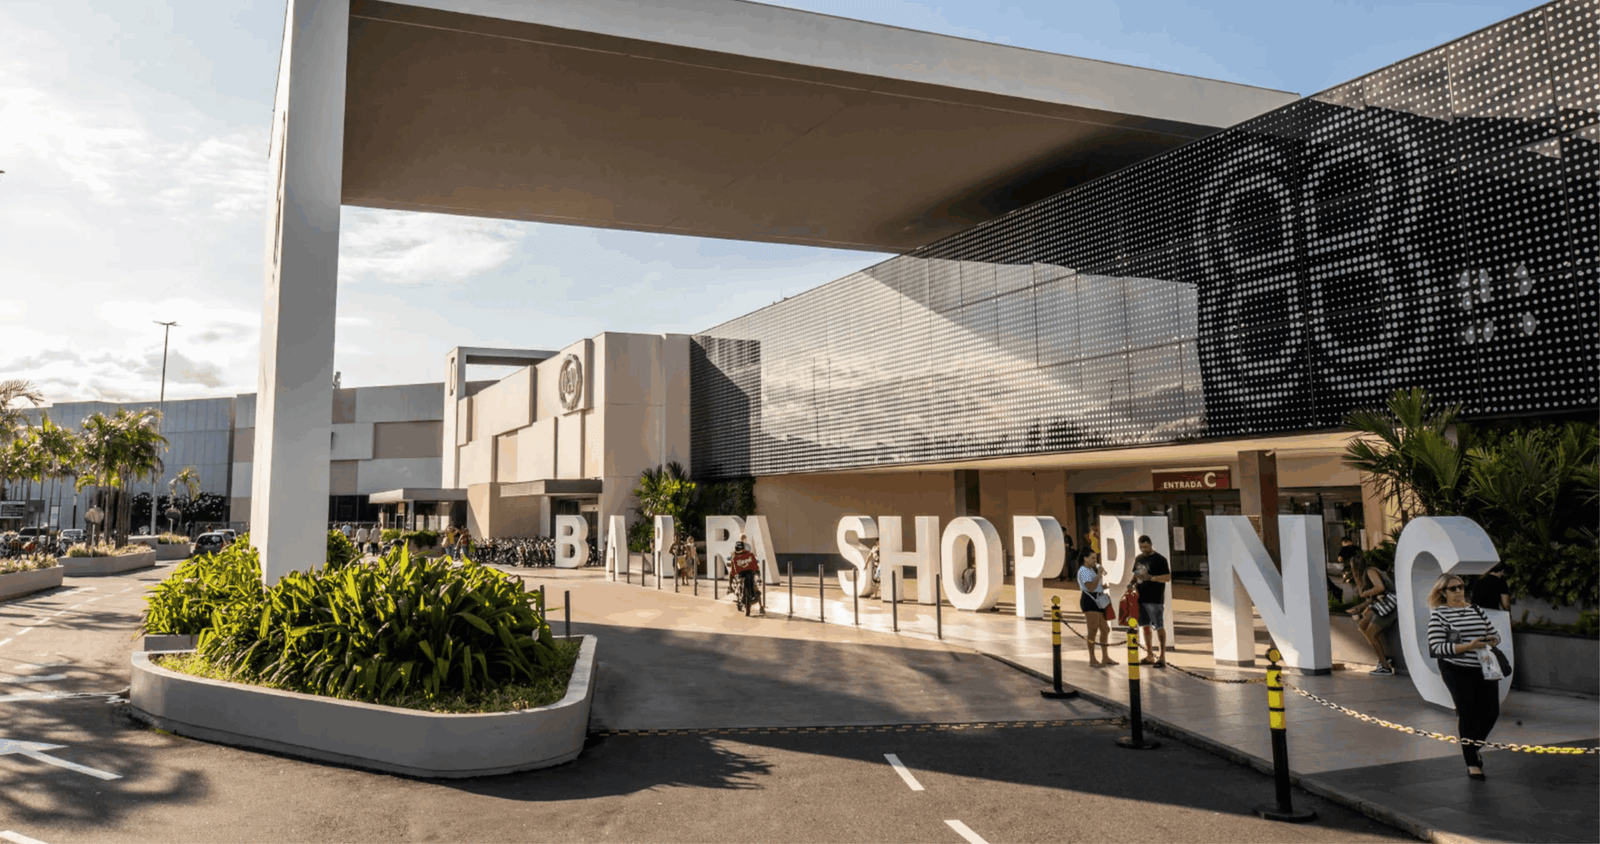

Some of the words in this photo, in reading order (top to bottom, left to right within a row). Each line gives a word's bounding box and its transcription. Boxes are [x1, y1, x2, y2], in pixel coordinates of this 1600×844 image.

[1163, 480, 1203, 489] ENTRADA
[1203, 471, 1217, 488] C
[555, 514, 781, 585] BARRA
[836, 514, 1514, 711] SHOPPING
